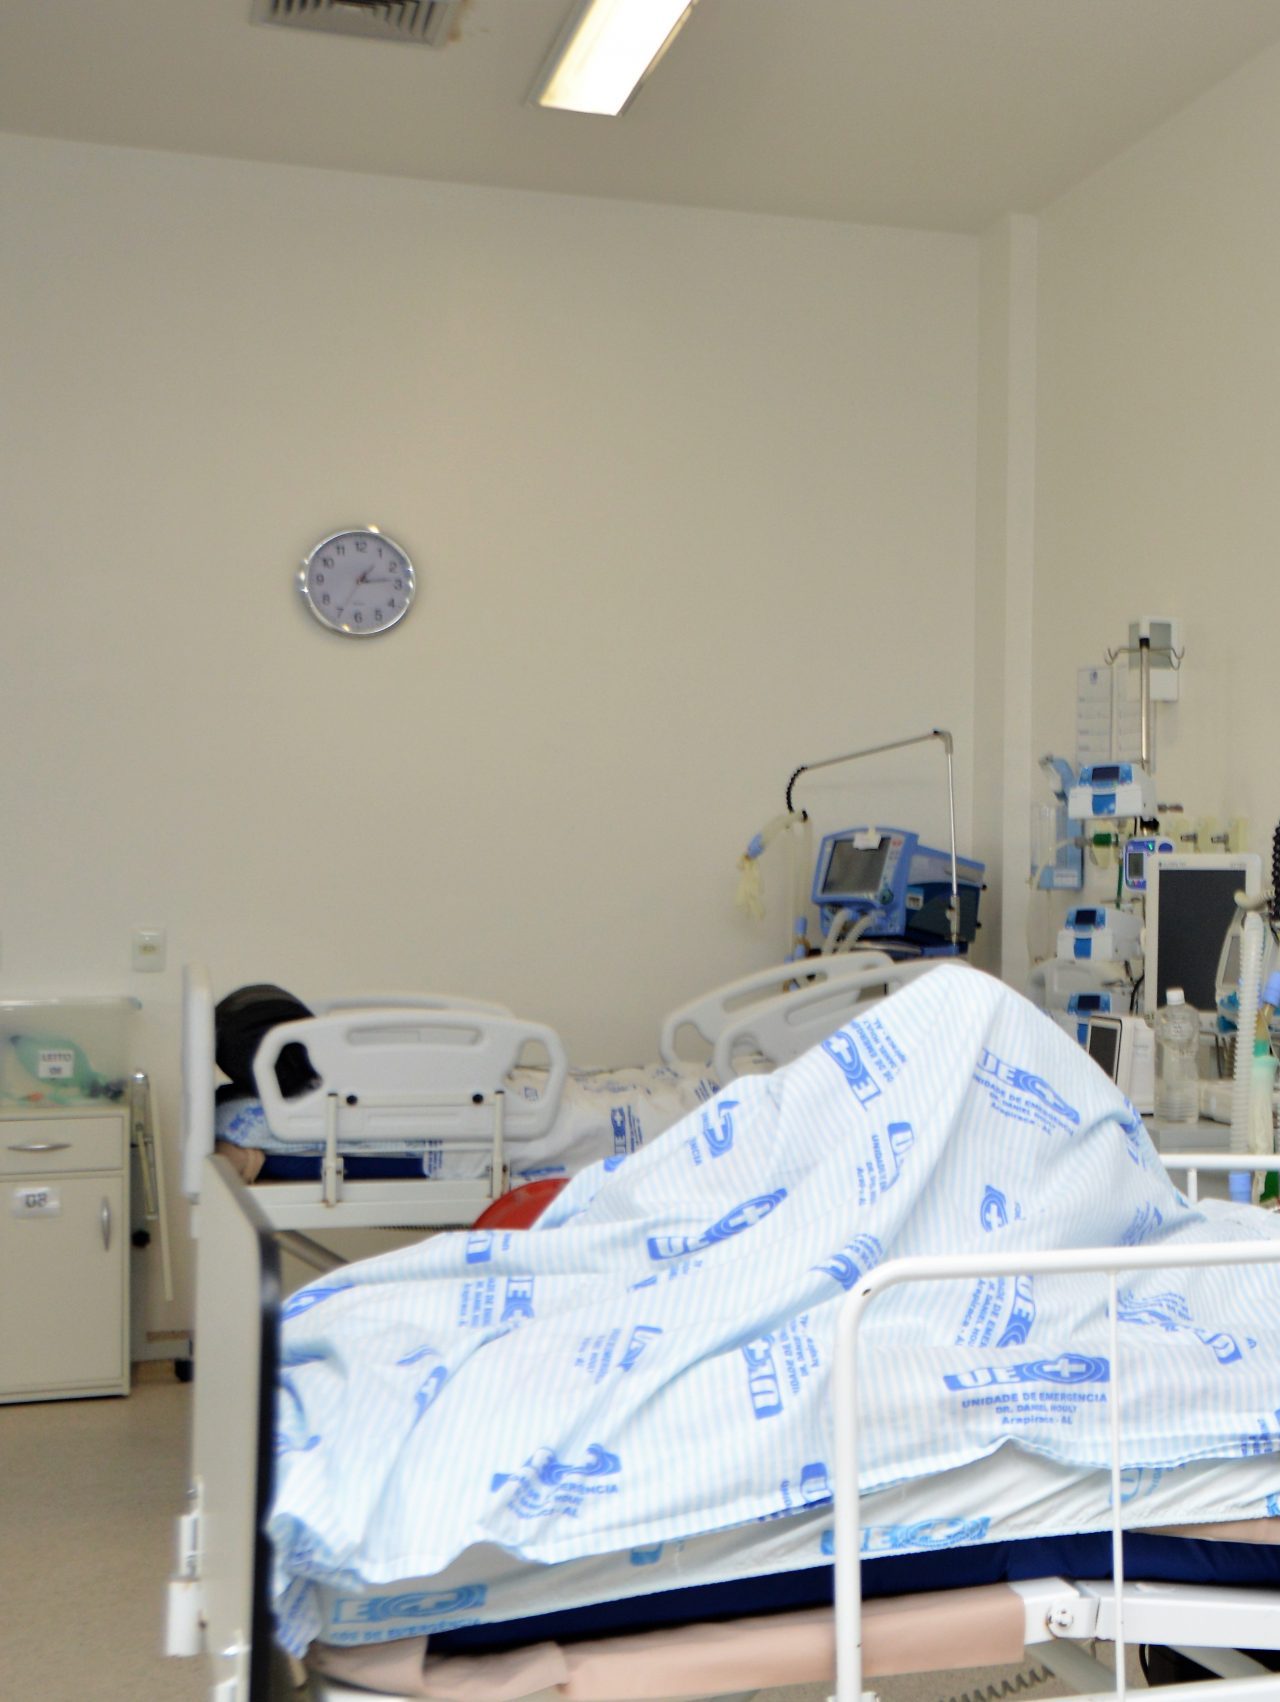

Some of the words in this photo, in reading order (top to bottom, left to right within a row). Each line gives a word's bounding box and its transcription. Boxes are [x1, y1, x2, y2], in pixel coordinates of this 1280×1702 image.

[336, 544, 345, 556] 11
[355, 541, 367, 553] 12
[322, 557, 335, 569] 10
[388, 561, 397, 573] 2
[316, 573, 324, 585] 9
[394, 580, 402, 590] 3
[322, 594, 330, 605] 8
[387, 598, 395, 608] 4
[336, 606, 344, 618] 7
[354, 611, 362, 623] 6
[375, 608, 383, 621] 5
[956, 1367, 1021, 1388] UE
[961, 1393, 1019, 1409] UNIDADE
[1022, 1392, 1037, 1401] DE
[1016, 1404, 1048, 1412] DANIEL
